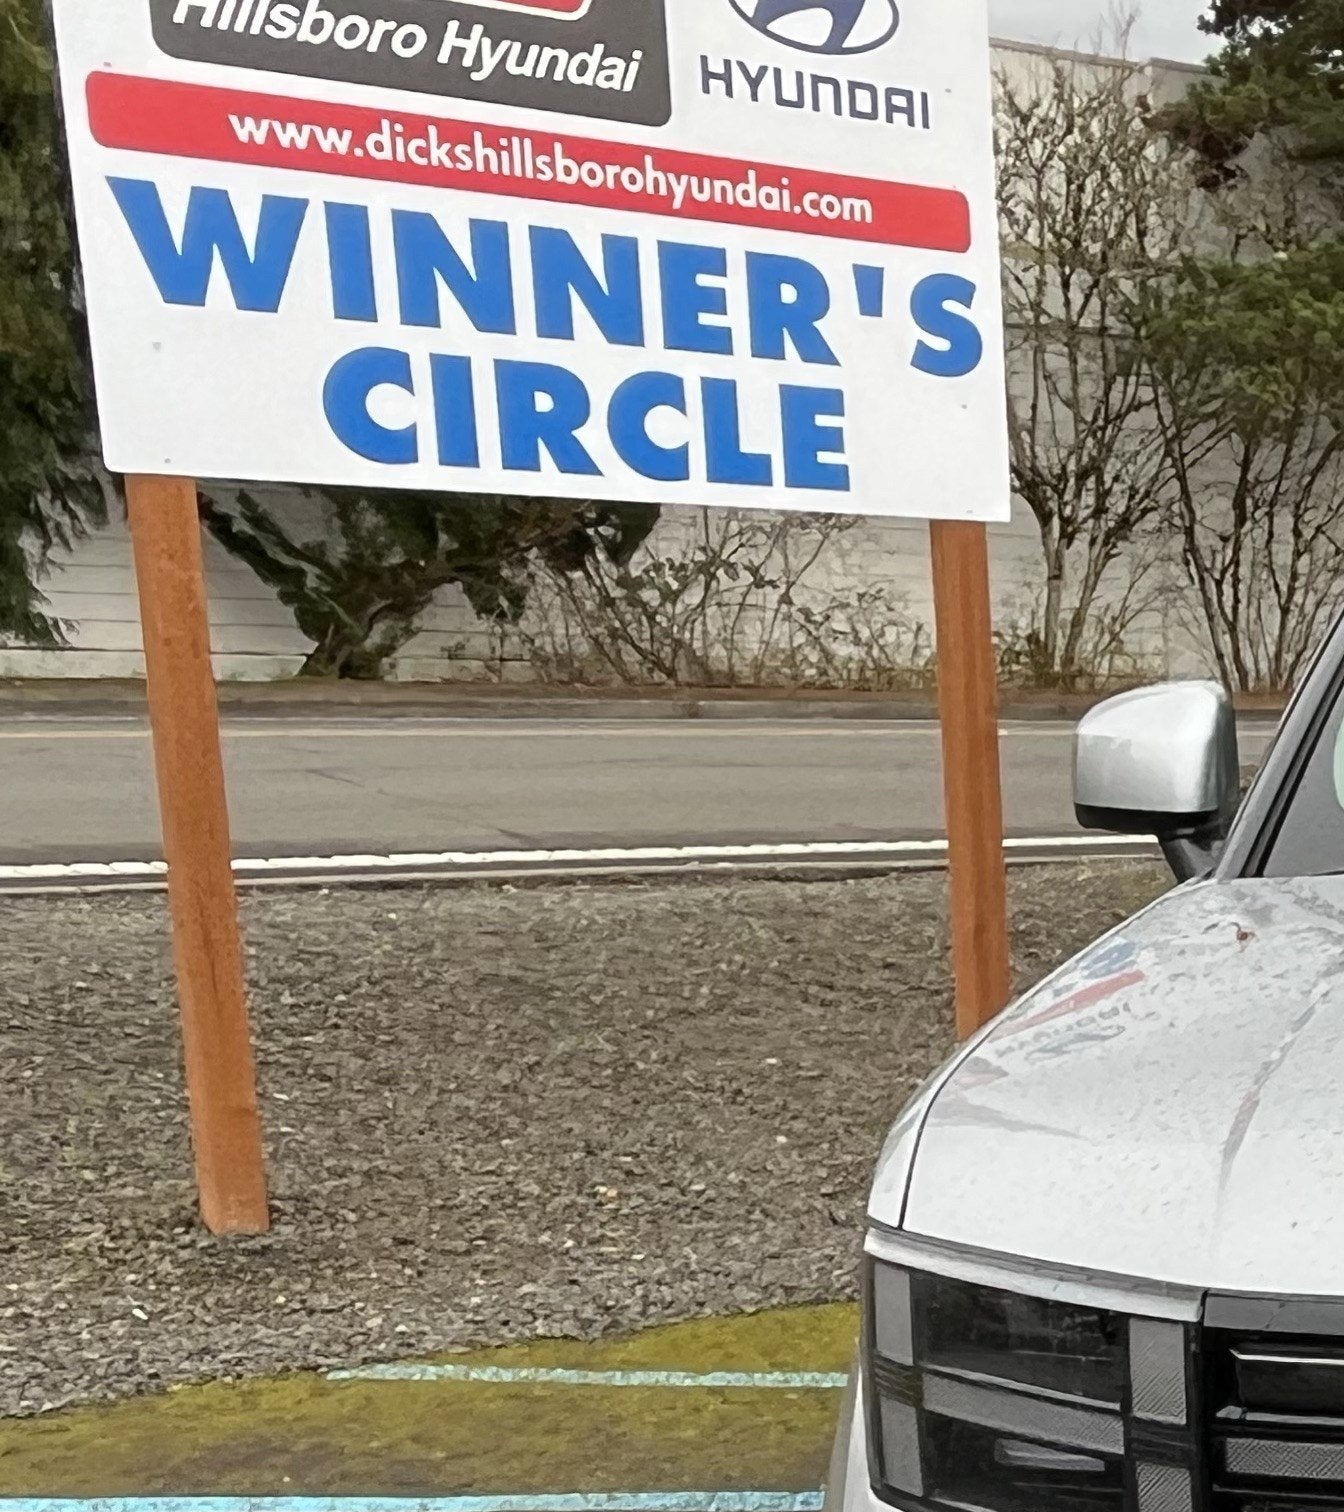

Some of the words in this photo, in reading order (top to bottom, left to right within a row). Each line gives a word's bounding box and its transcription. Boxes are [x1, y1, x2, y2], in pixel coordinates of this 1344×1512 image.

[436, 19, 643, 92] Hyundai
[699, 54, 931, 130] HYUNDAI
[228, 114, 873, 223] www.dickshillsborohyundai.com
[107, 175, 983, 377] WINNER'S
[322, 346, 850, 491] CIRCLE
